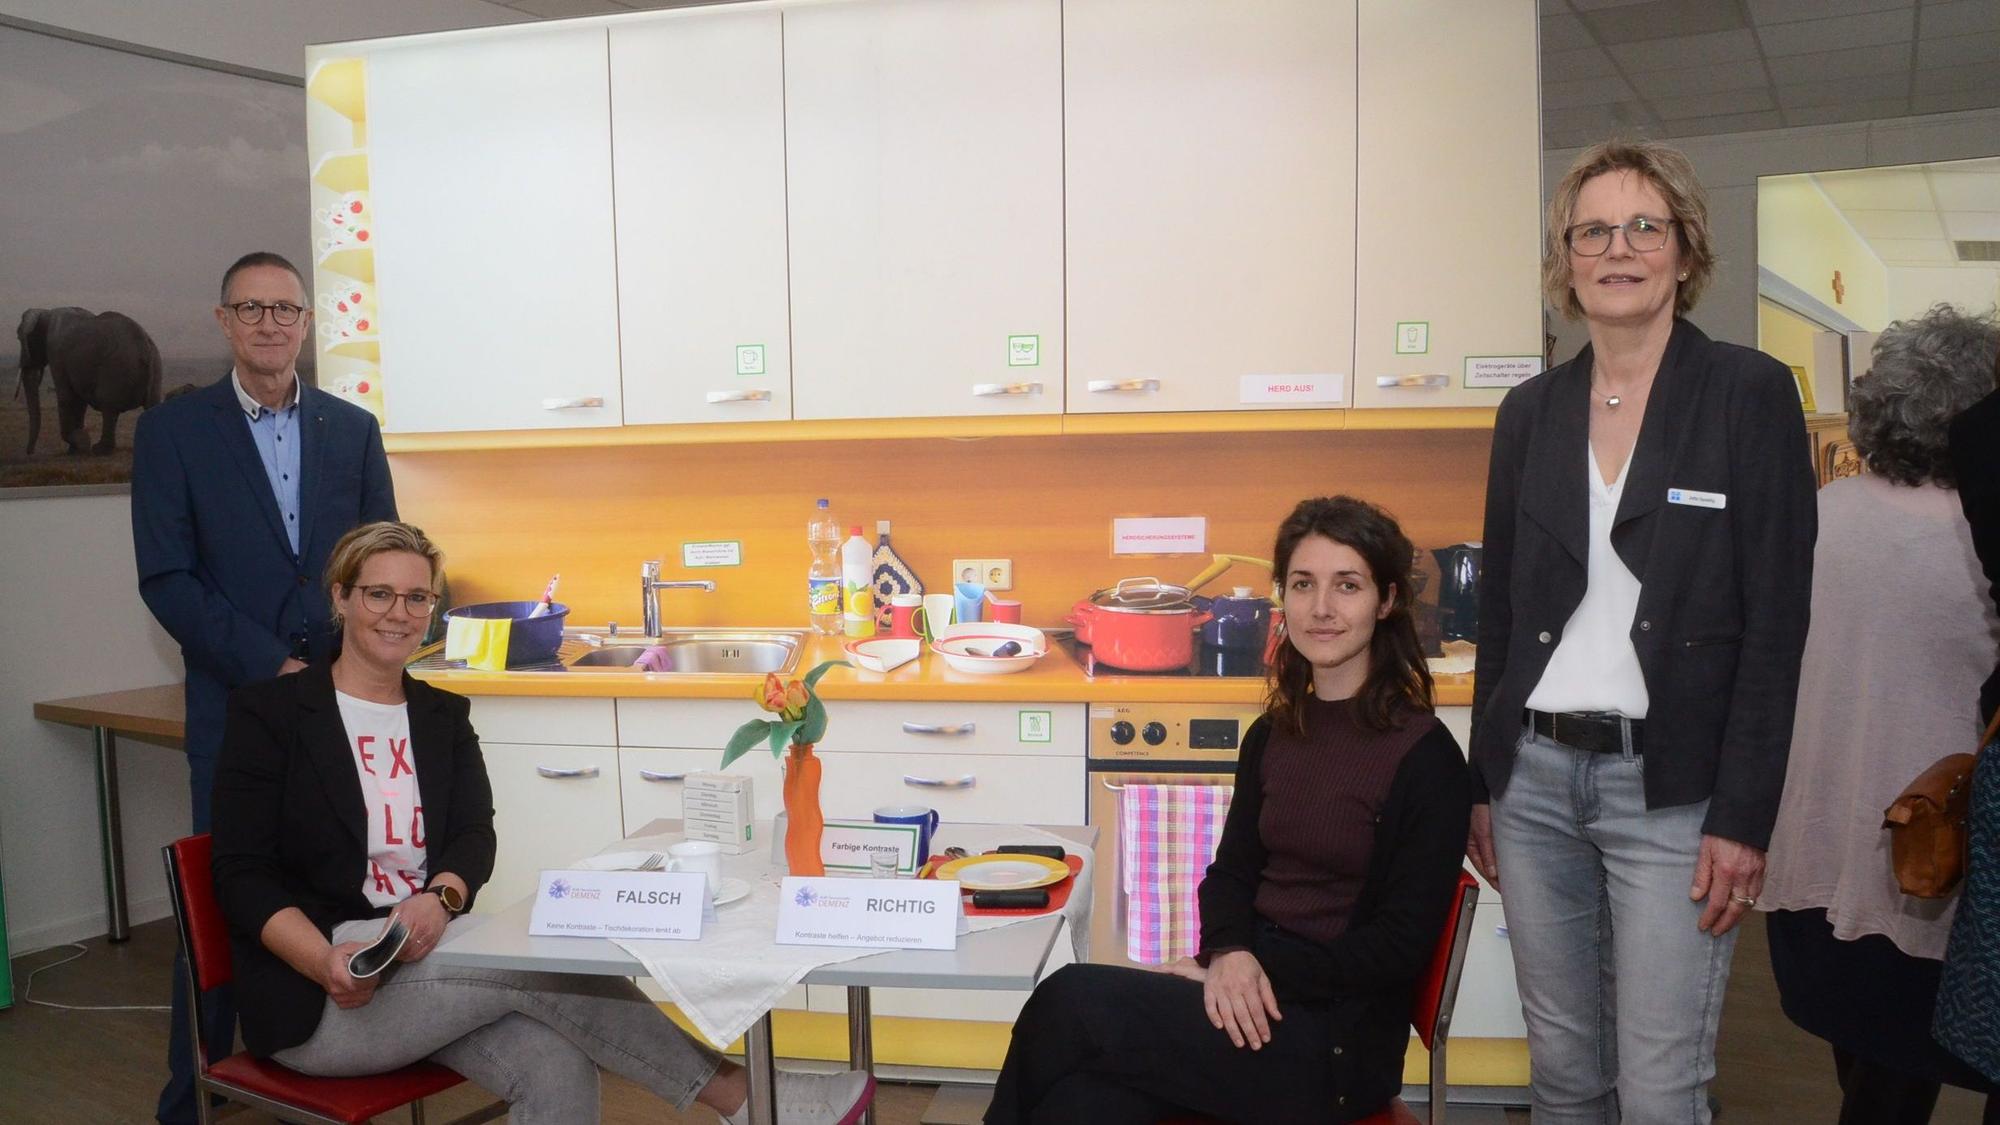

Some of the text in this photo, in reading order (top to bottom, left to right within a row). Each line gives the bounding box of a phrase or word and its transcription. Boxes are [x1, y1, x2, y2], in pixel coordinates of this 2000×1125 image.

[1267, 383, 1315, 393] HERD AUS!
[357, 735, 414, 779] EX
[367, 803, 428, 849] LO
[831, 842, 900, 853] Farbige Kontraste
[616, 890, 682, 905] FALSCH
[866, 898, 936, 914] RICHTIG
[546, 921, 565, 930] Keine
[566, 922, 597, 931] Kontraste
[794, 931, 827, 940] Kontraste
[827, 932, 850, 941] helfen
[856, 934, 885, 944] Angebot
[886, 935, 922, 945] reduzieren
